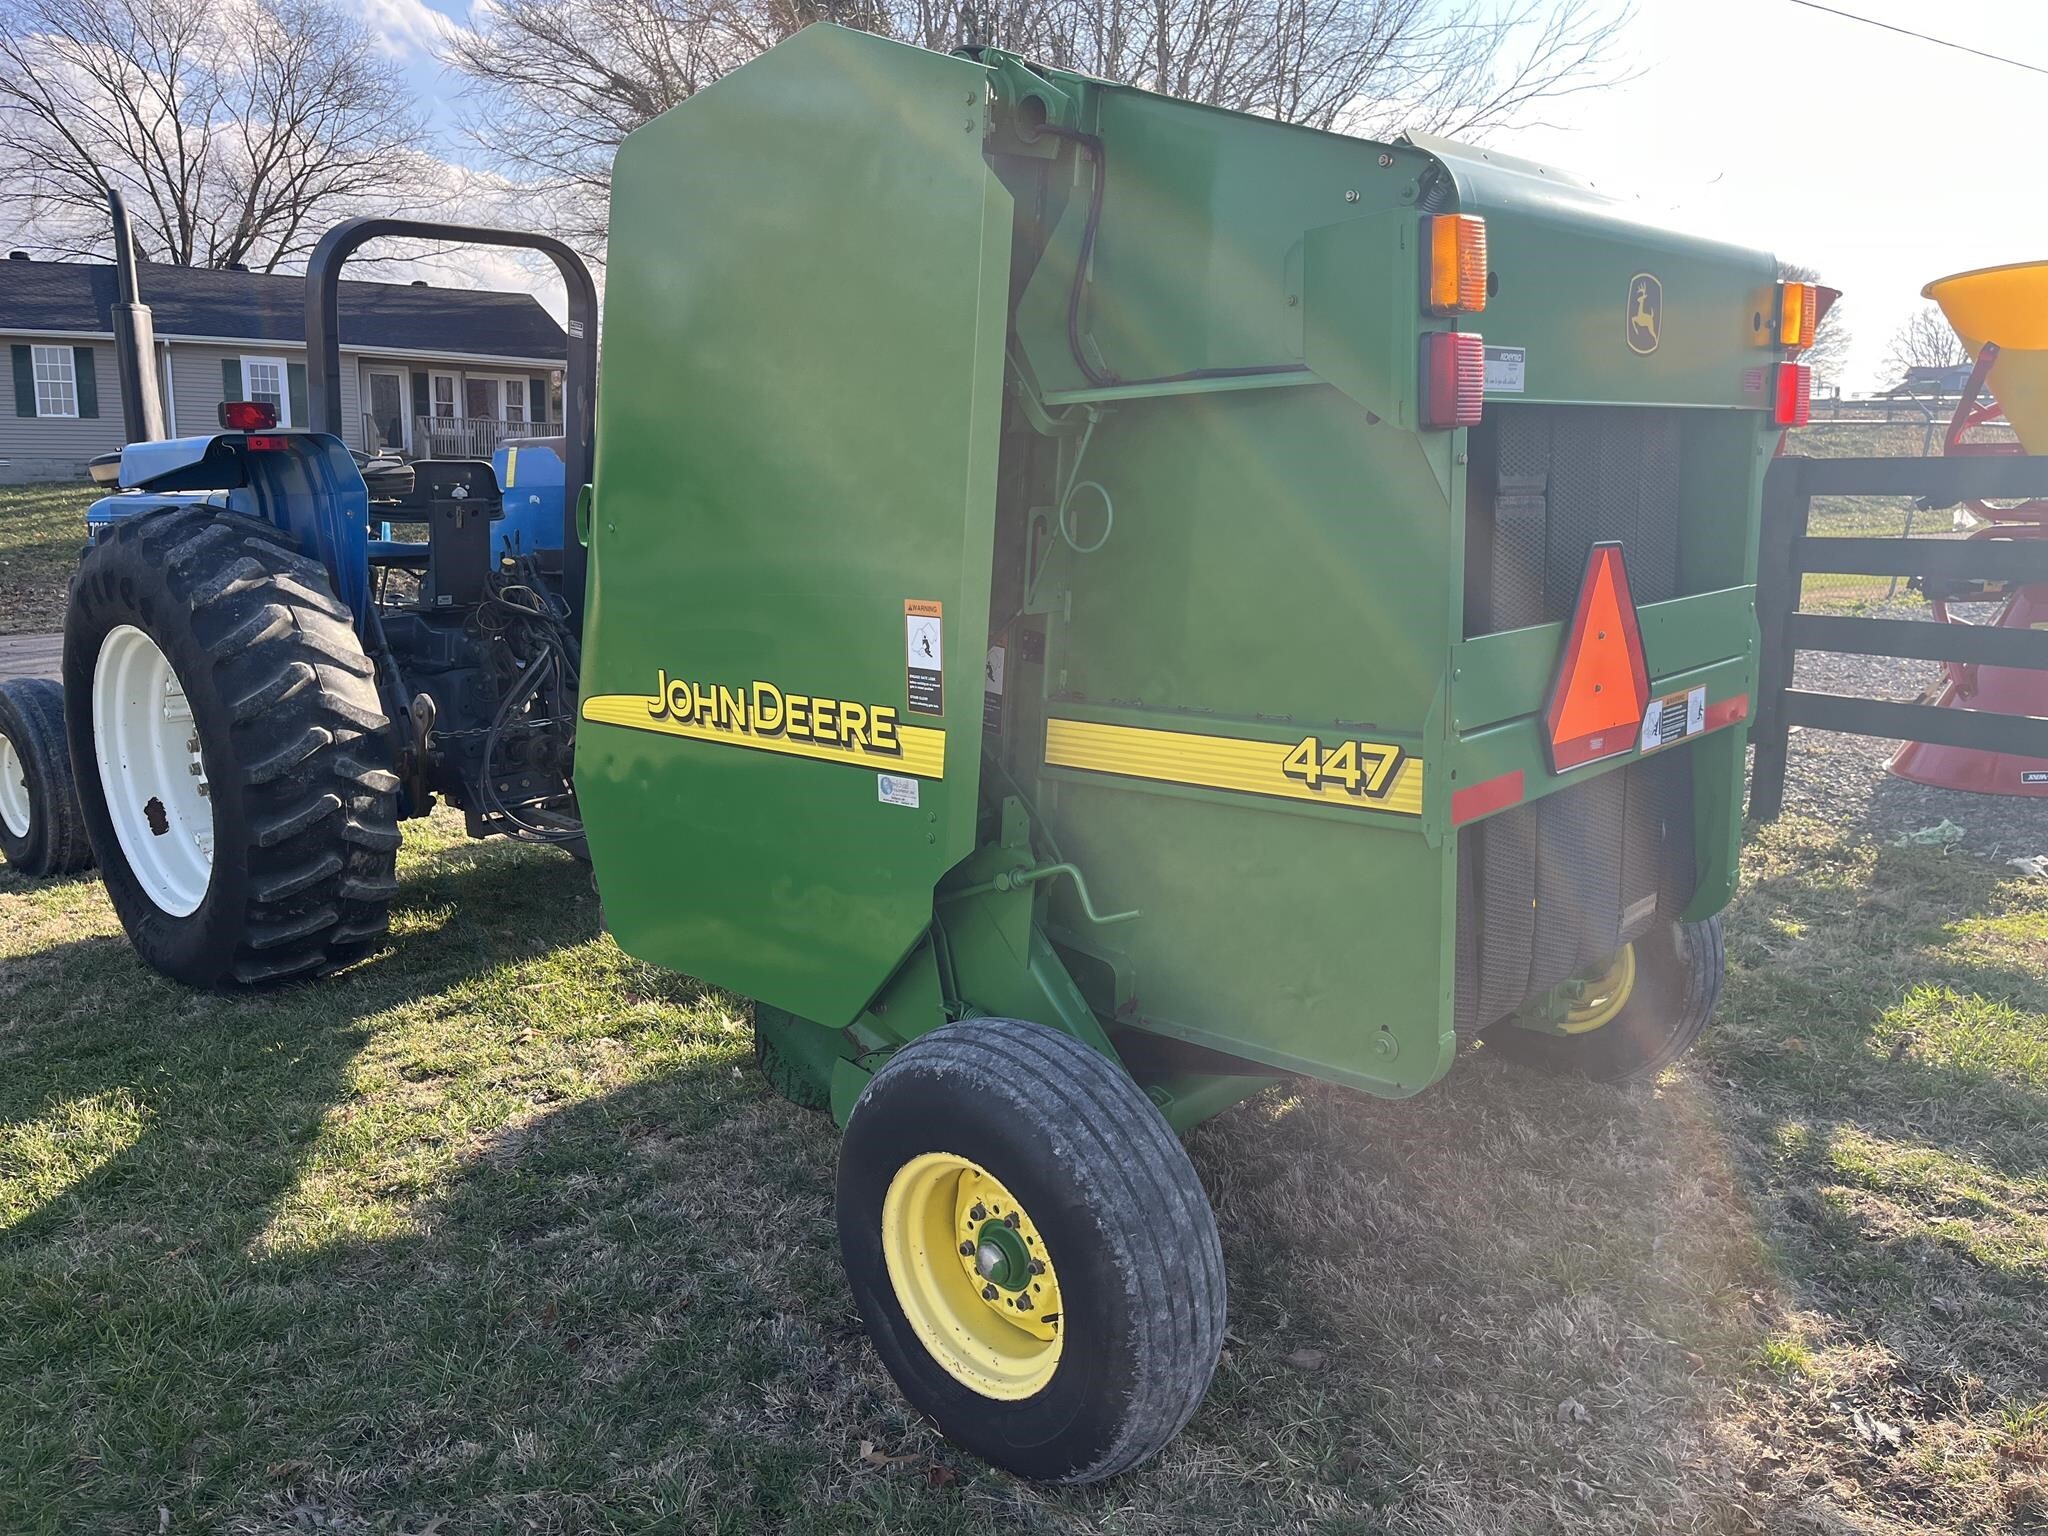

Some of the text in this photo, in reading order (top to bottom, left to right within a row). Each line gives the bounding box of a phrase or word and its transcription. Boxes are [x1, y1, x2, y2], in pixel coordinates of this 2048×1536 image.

[912, 604, 937, 613] WARNING
[648, 669, 900, 752] JOHN DEERE
[1282, 735, 1405, 798] 447
